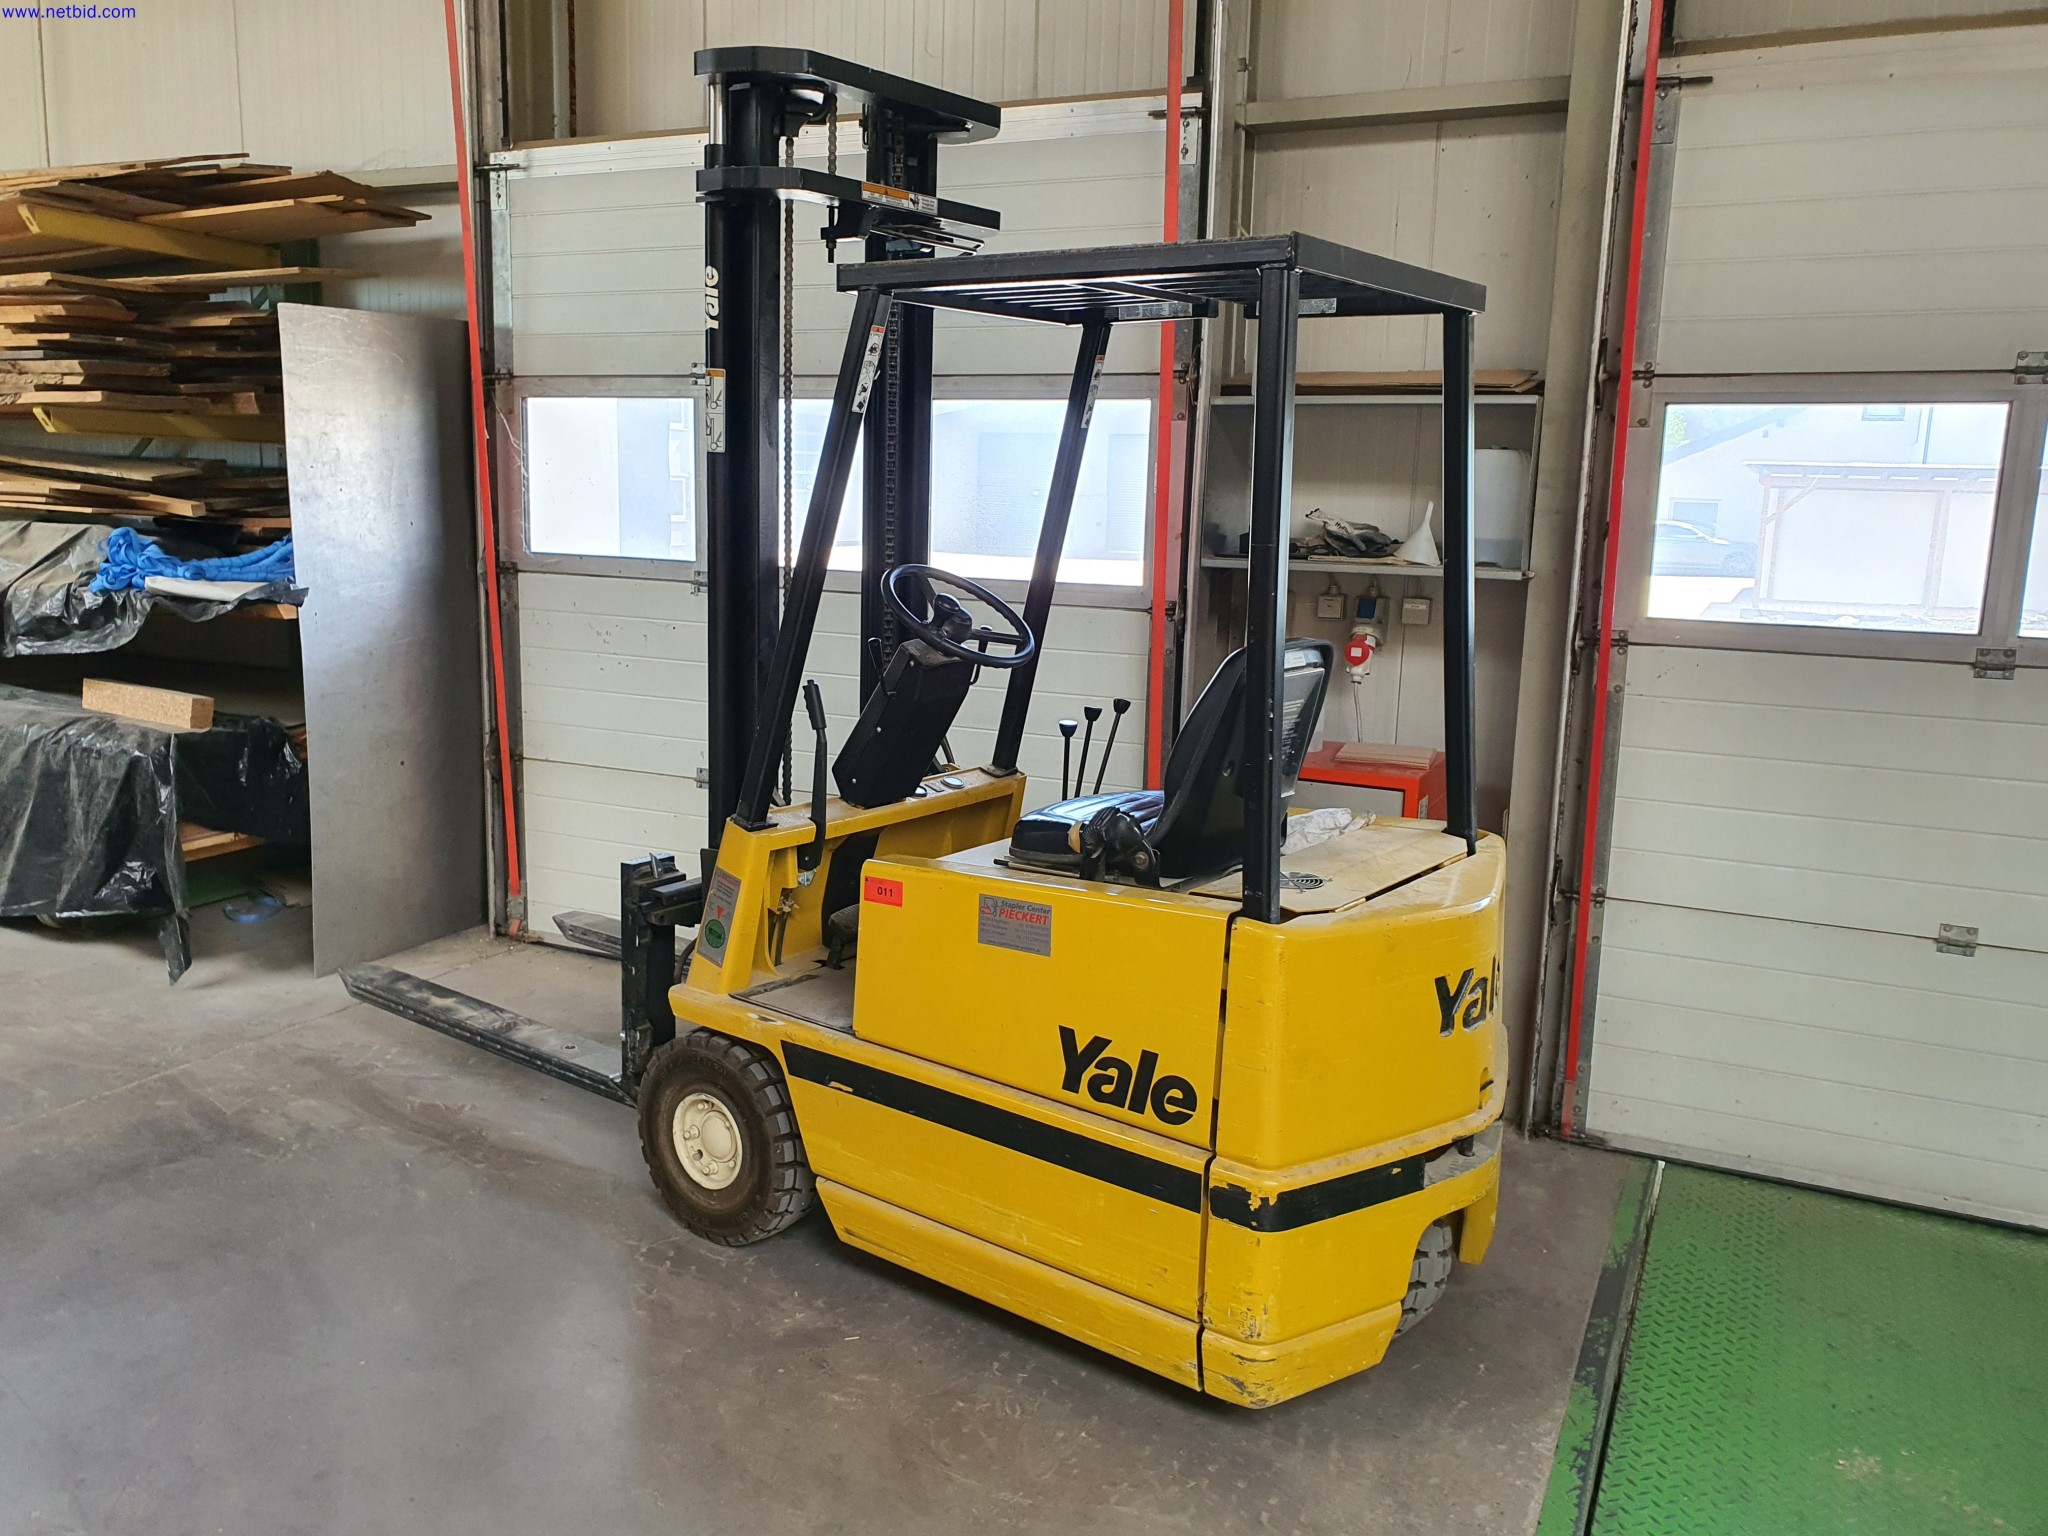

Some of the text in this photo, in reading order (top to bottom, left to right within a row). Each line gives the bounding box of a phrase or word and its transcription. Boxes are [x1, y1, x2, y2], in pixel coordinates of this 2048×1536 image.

[705, 265, 720, 330] Yale
[877, 886, 893, 898] 011
[1000, 900, 1050, 915] Stapler Center
[998, 908, 1049, 926] PIECKERT
[1434, 954, 1500, 1037] Yal
[1058, 1025, 1198, 1126] Yale
